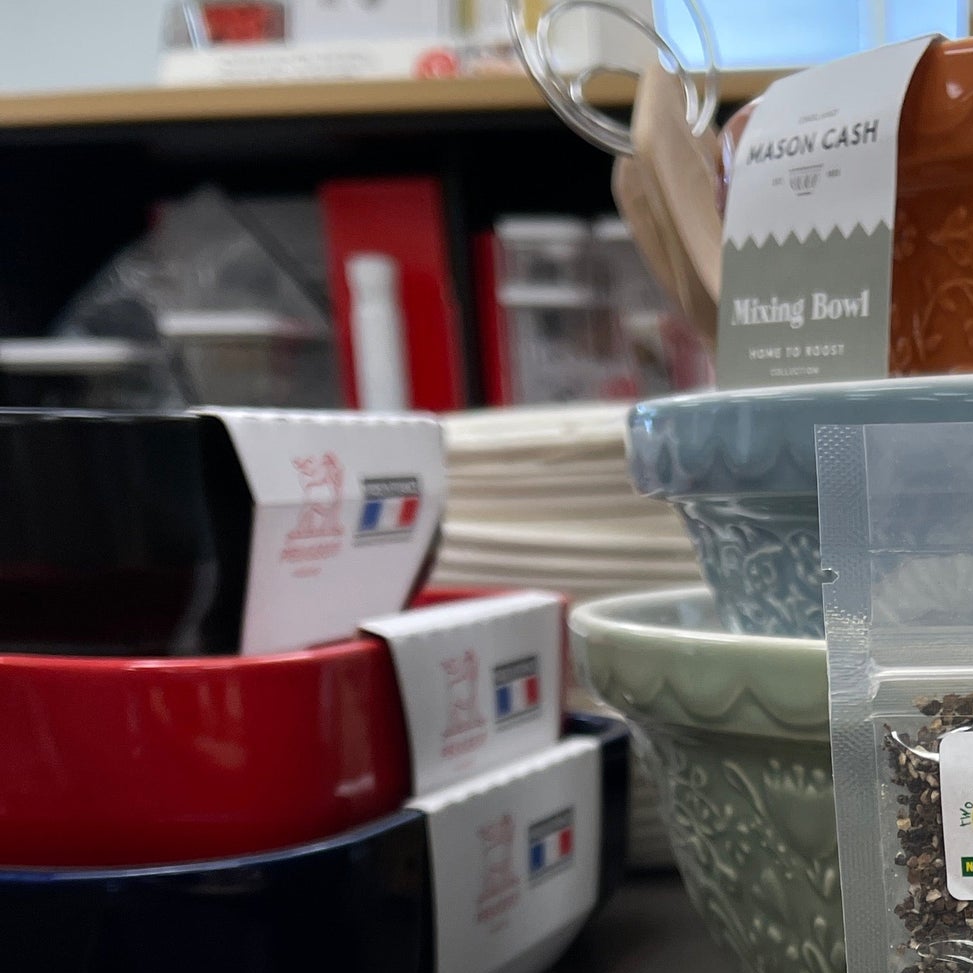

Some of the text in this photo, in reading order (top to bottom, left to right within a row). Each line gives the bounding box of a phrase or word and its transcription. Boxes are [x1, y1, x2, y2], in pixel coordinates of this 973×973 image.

[746, 118, 880, 166] MASON CASH
[731, 288, 870, 329] Mixing Bowl
[785, 346, 801, 358] TO
[960, 801, 973, 827] two
